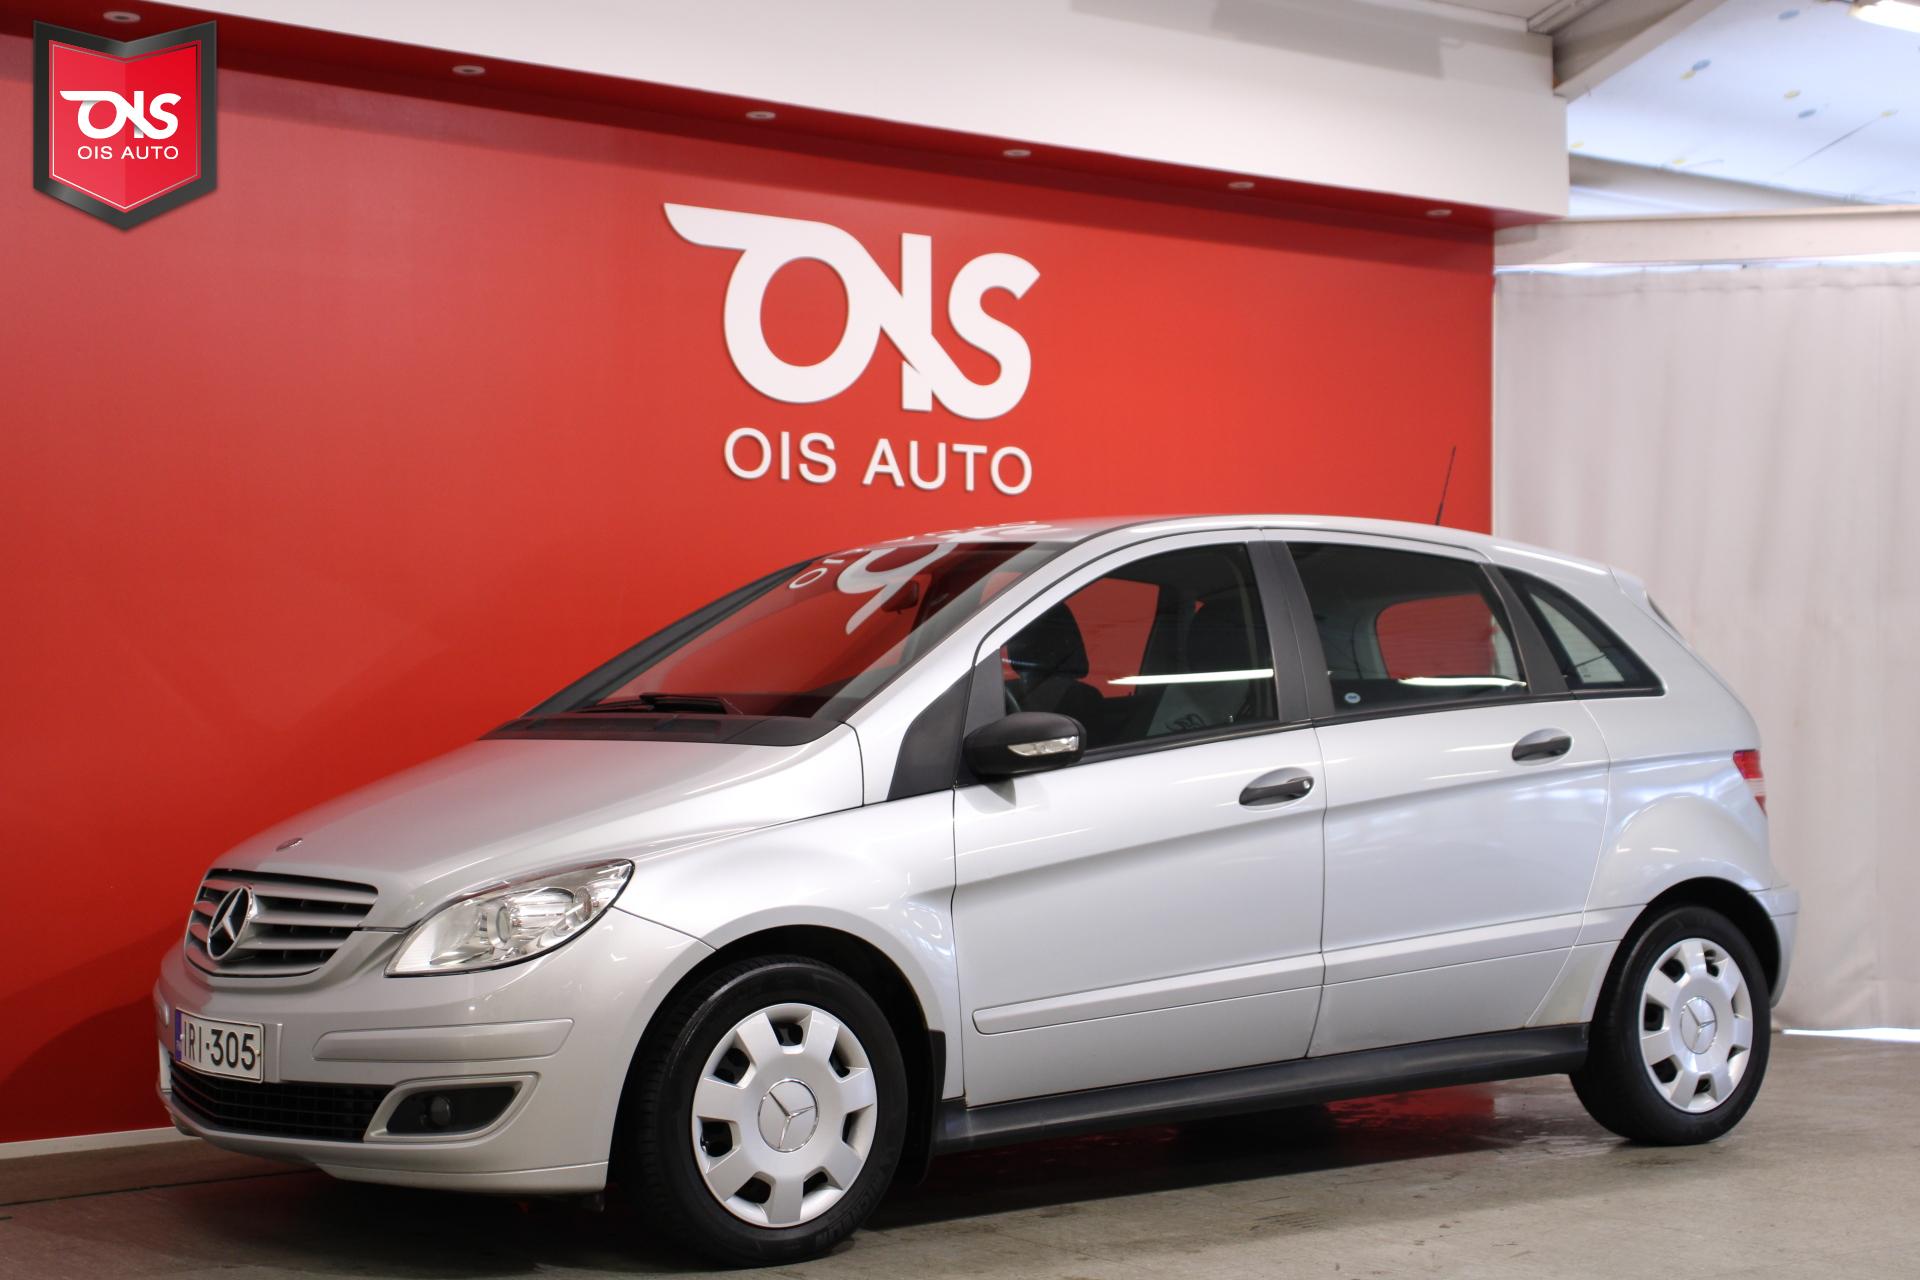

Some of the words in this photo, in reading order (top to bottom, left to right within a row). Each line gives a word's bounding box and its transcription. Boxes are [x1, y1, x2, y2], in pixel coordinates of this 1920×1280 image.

[724, 427, 837, 484] OIS
[862, 438, 1033, 495] AUTO
[184, 1021, 256, 1071] IRI-305
